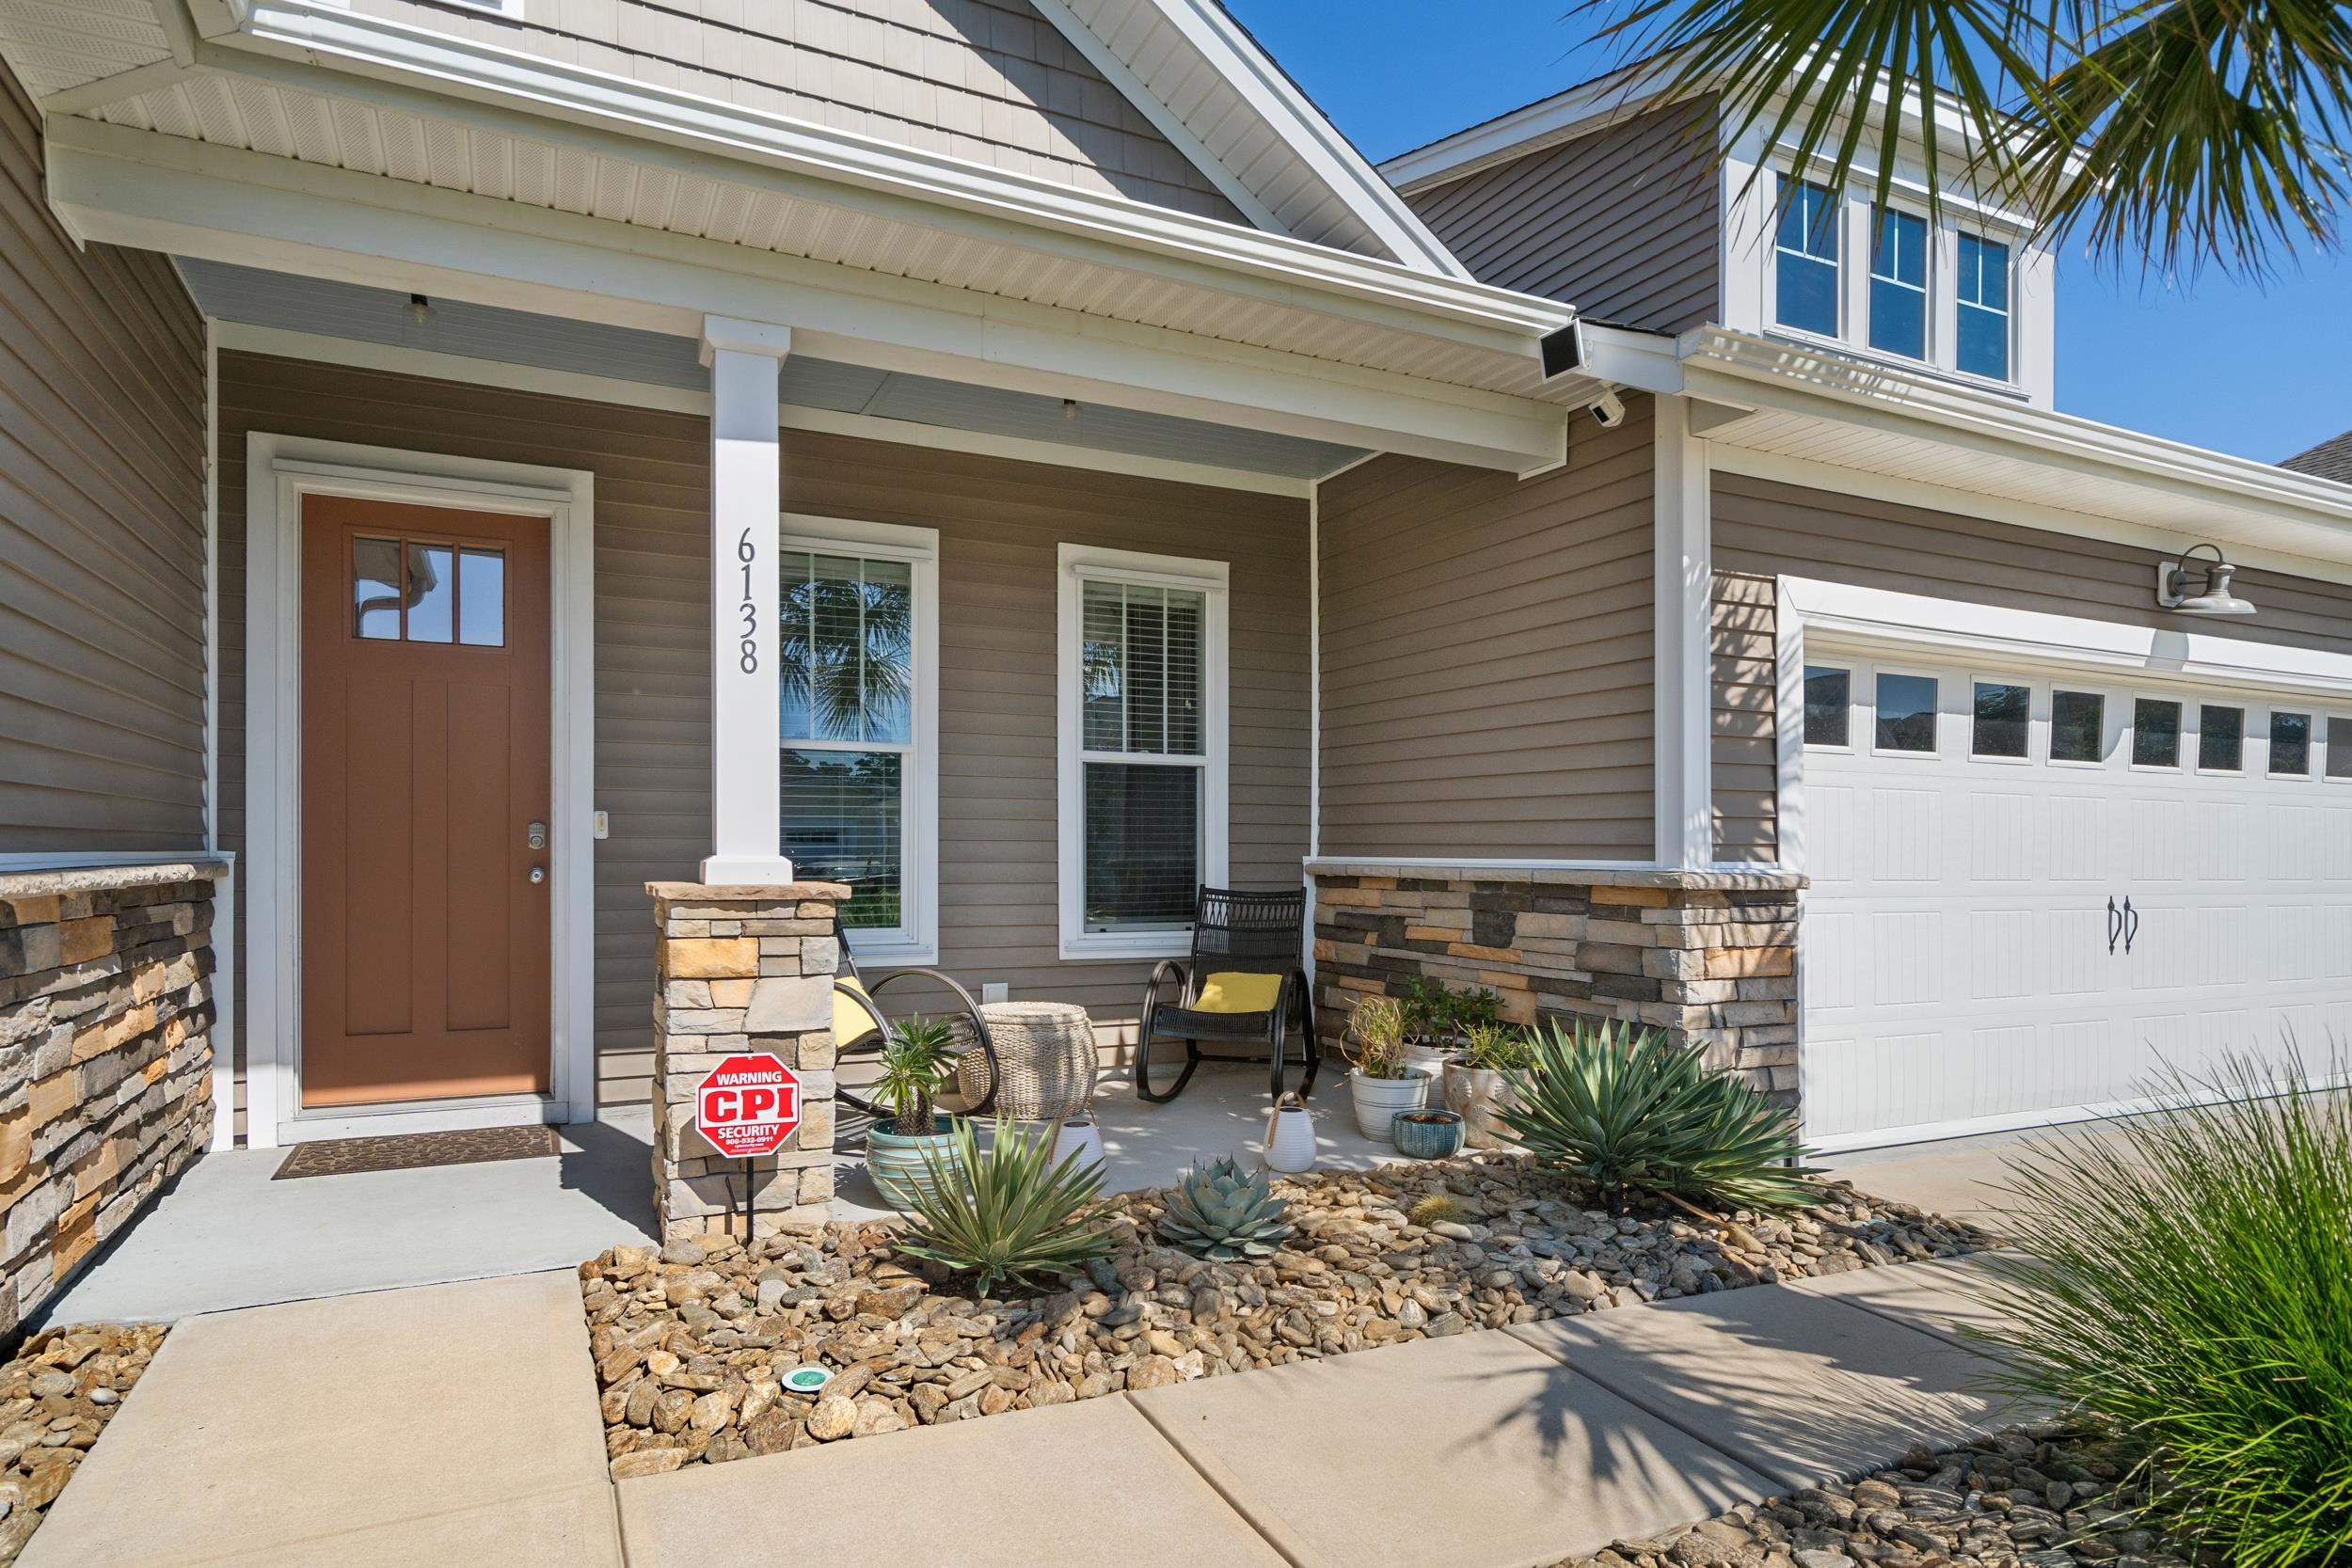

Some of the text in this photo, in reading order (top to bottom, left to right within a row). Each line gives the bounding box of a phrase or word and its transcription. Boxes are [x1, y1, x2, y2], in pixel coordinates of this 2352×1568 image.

[738, 527, 757, 674] 6138
[716, 1070, 783, 1085] WARNING
[705, 1087, 794, 1123] CPI
[717, 1124, 780, 1139] SECURITY
